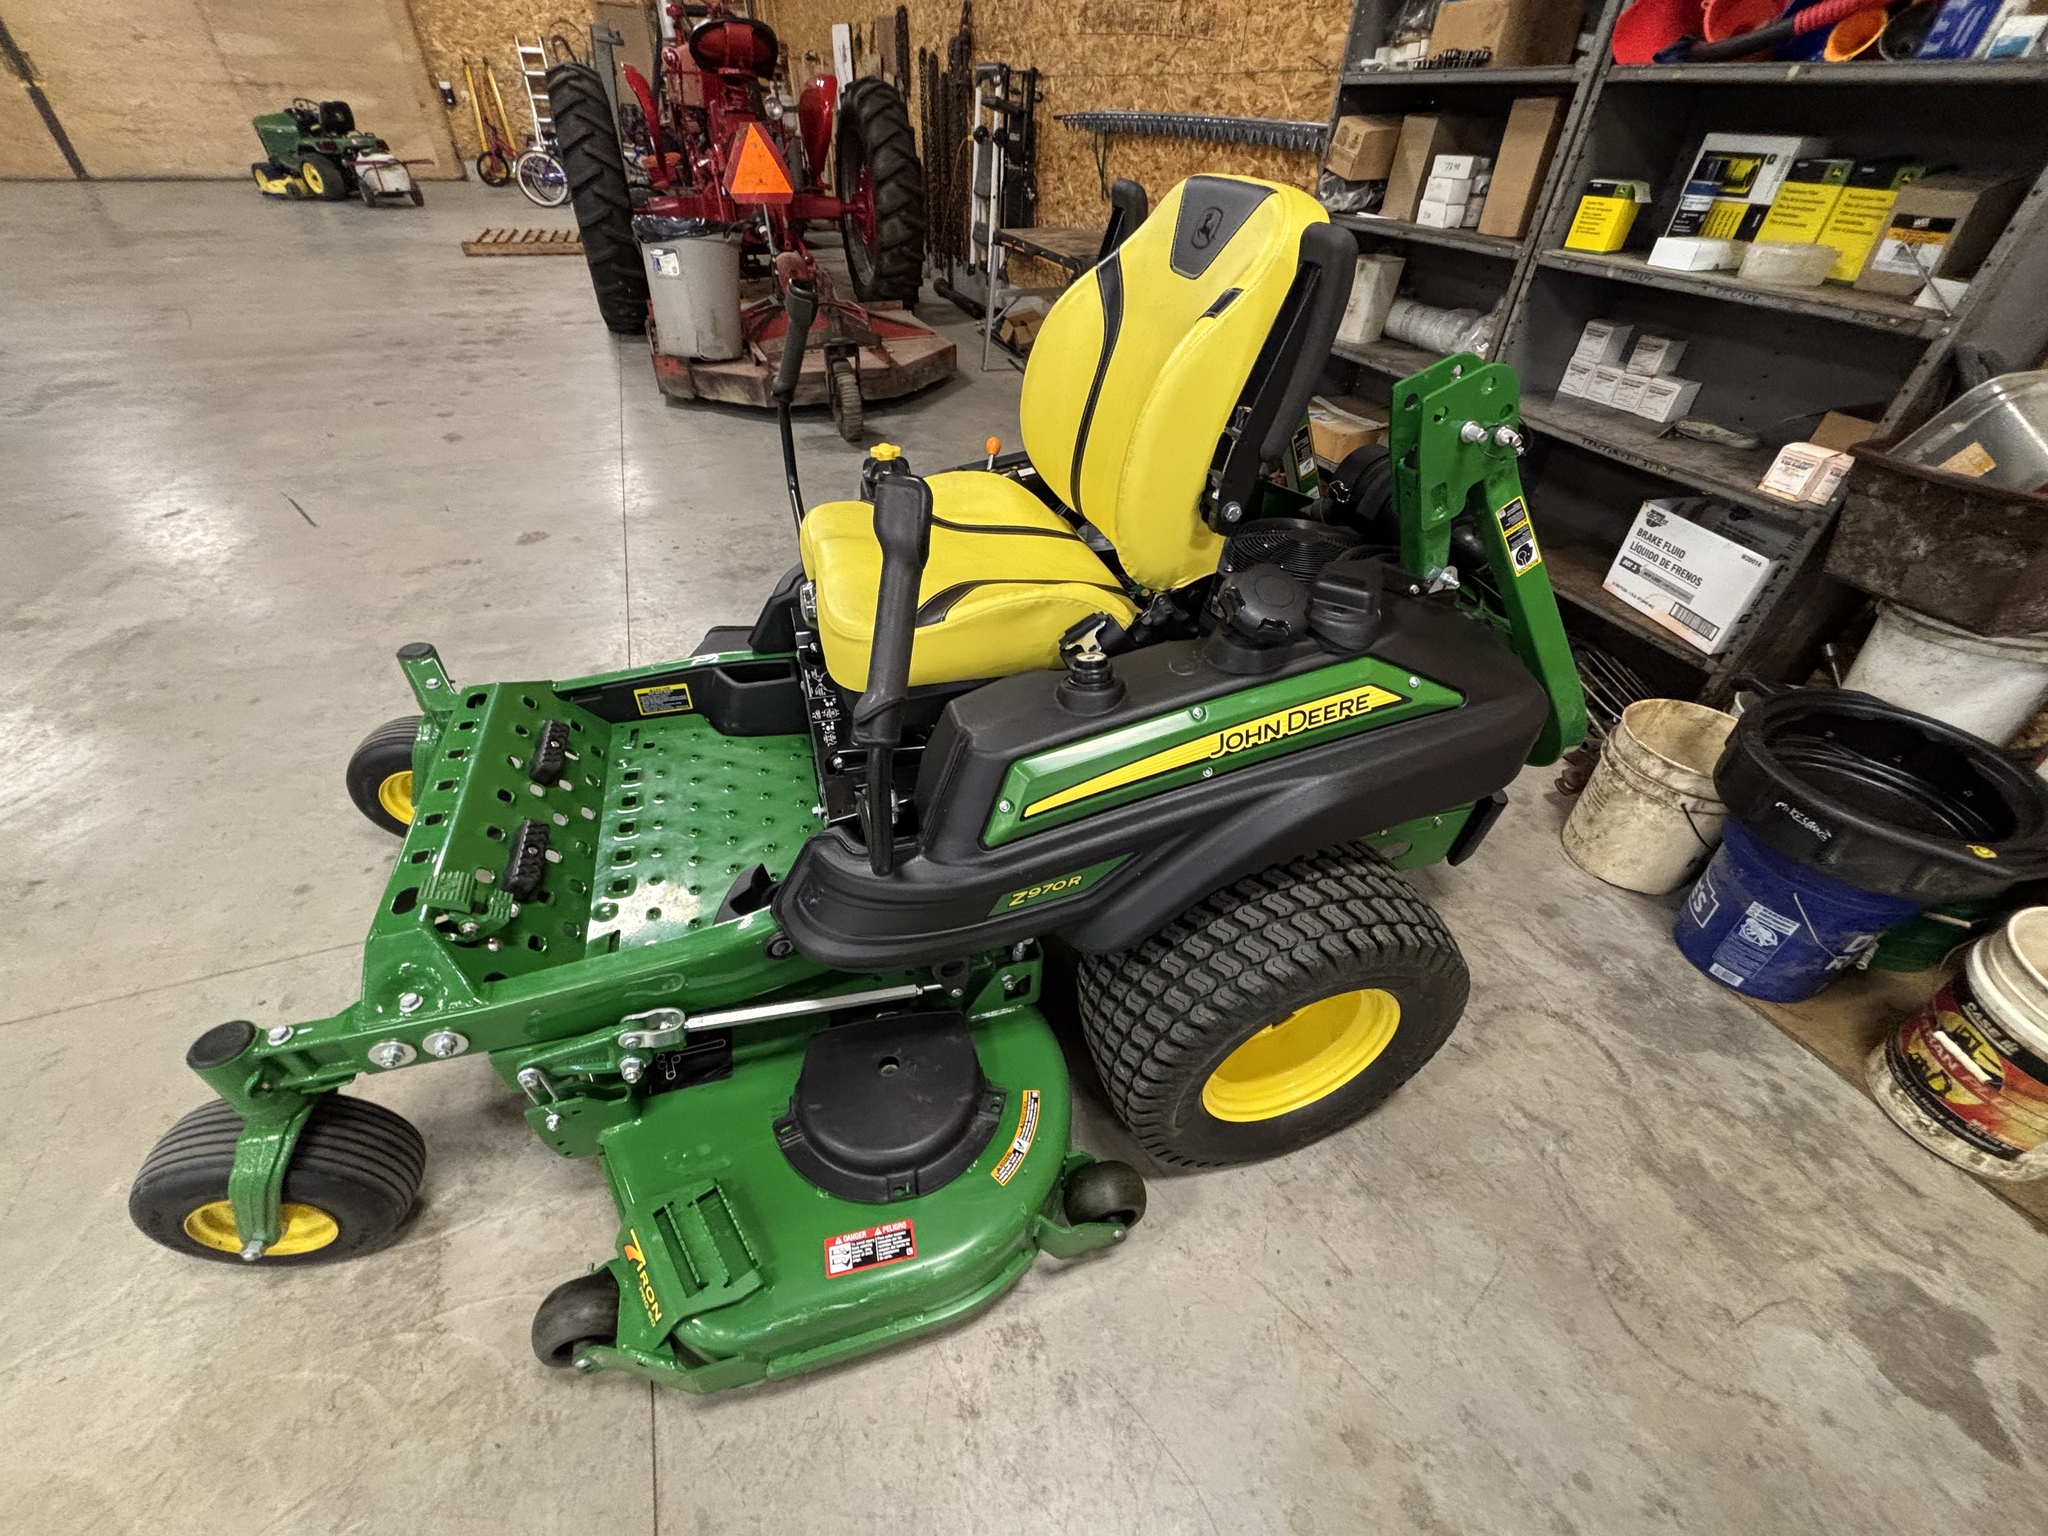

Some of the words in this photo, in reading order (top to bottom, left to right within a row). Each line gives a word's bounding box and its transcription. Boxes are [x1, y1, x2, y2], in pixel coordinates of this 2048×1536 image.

[1636, 527, 1664, 548] BRAKE
[1664, 541, 1686, 559] FLUID
[1629, 541, 1660, 563] LÍQUIDO
[1659, 556, 1670, 570] DE
[1670, 562, 1703, 588] FRENOS
[1210, 720, 1281, 756] JOHN
[1287, 693, 1371, 733] DEERE
[1008, 875, 1082, 907] Z970R
[1967, 1001, 2003, 1039] CASE
[842, 1230, 867, 1243] DANGER
[882, 1221, 907, 1234] PELIGRO
